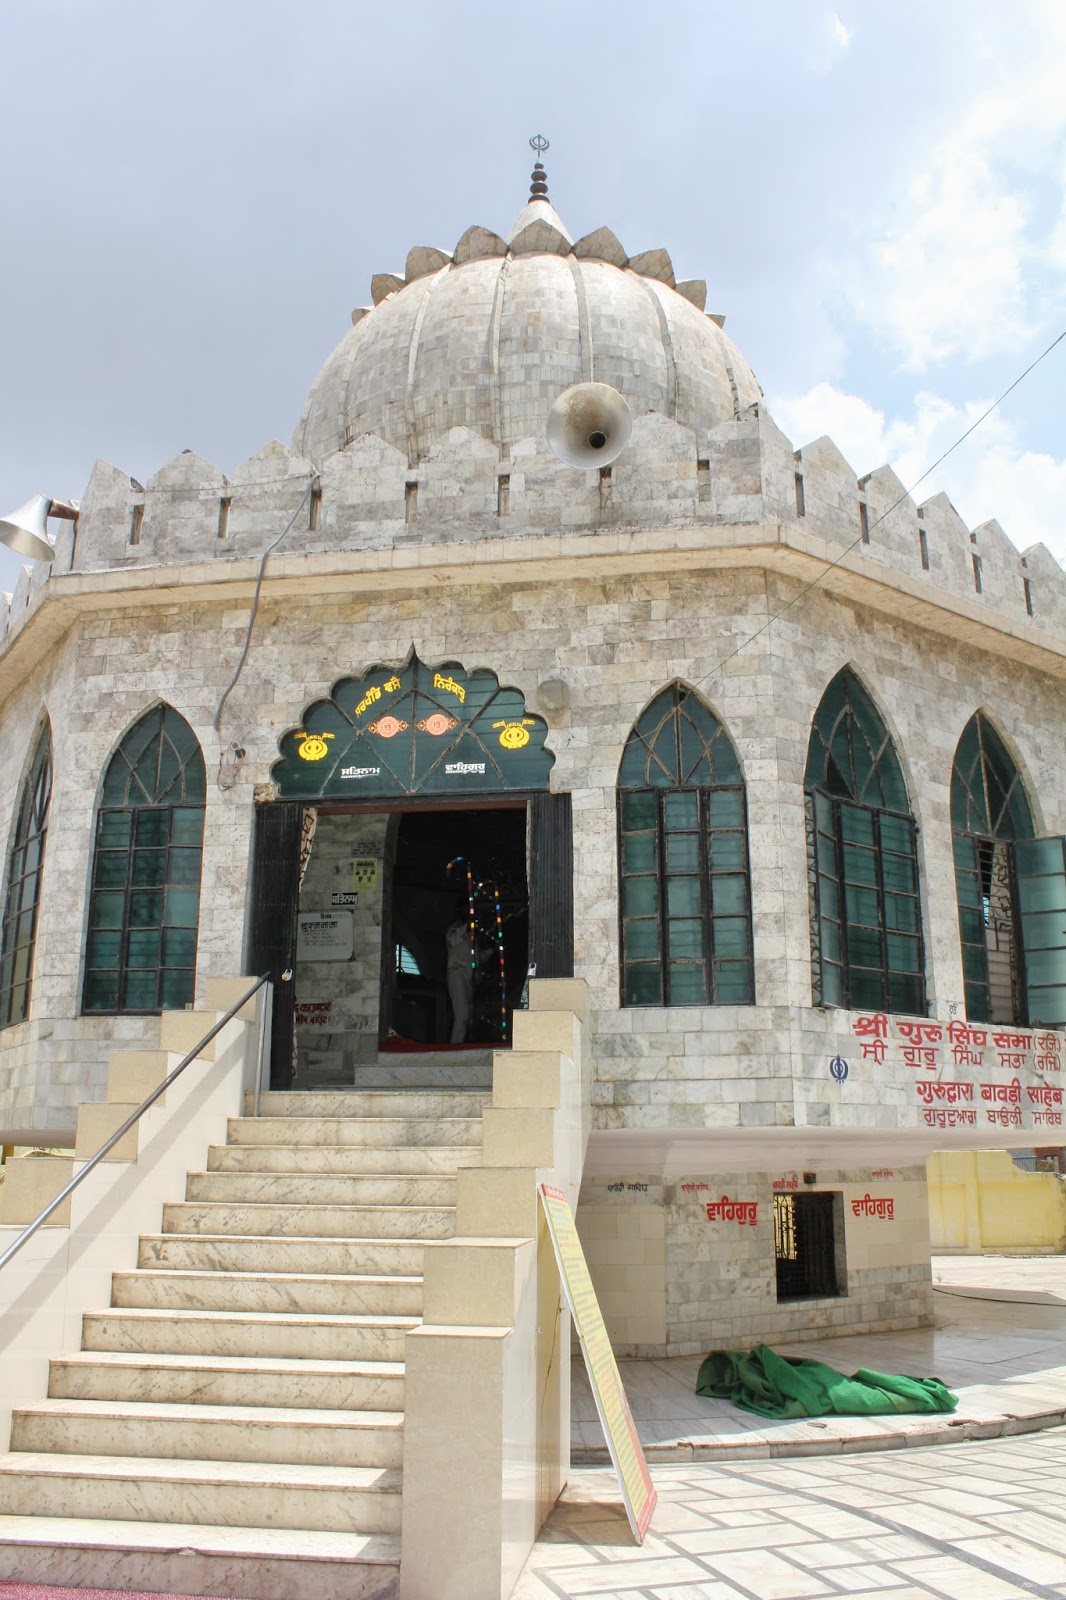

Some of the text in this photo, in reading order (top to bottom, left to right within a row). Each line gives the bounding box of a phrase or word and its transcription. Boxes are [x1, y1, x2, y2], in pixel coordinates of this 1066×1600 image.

[852, 1013, 888, 1038] श्री
[896, 1021, 943, 1045] गुरू
[946, 1020, 987, 1046] सिंघ
[991, 1032, 1032, 1050] सभा
[860, 1039, 888, 1065] ਸ੍ਰੀ
[899, 1046, 939, 1070] ਗੁਰੂ
[951, 1045, 984, 1066] ਸਿੰਘ
[997, 1052, 1027, 1069] ਸਭਾ
[980, 1077, 1022, 1105] बावड़ी
[1026, 1081, 1065, 1107] साहेब
[922, 1106, 1062, 1129] ਗੁਰੂਦੁਆਰਾ ਬਾਉਲੀ ਸਾਹਿਬ
[706, 1196, 758, 1226] ਵਾਹਿਗੁਰੂ
[851, 1193, 894, 1220] ਵਾਹਿਗੁਰੂ
